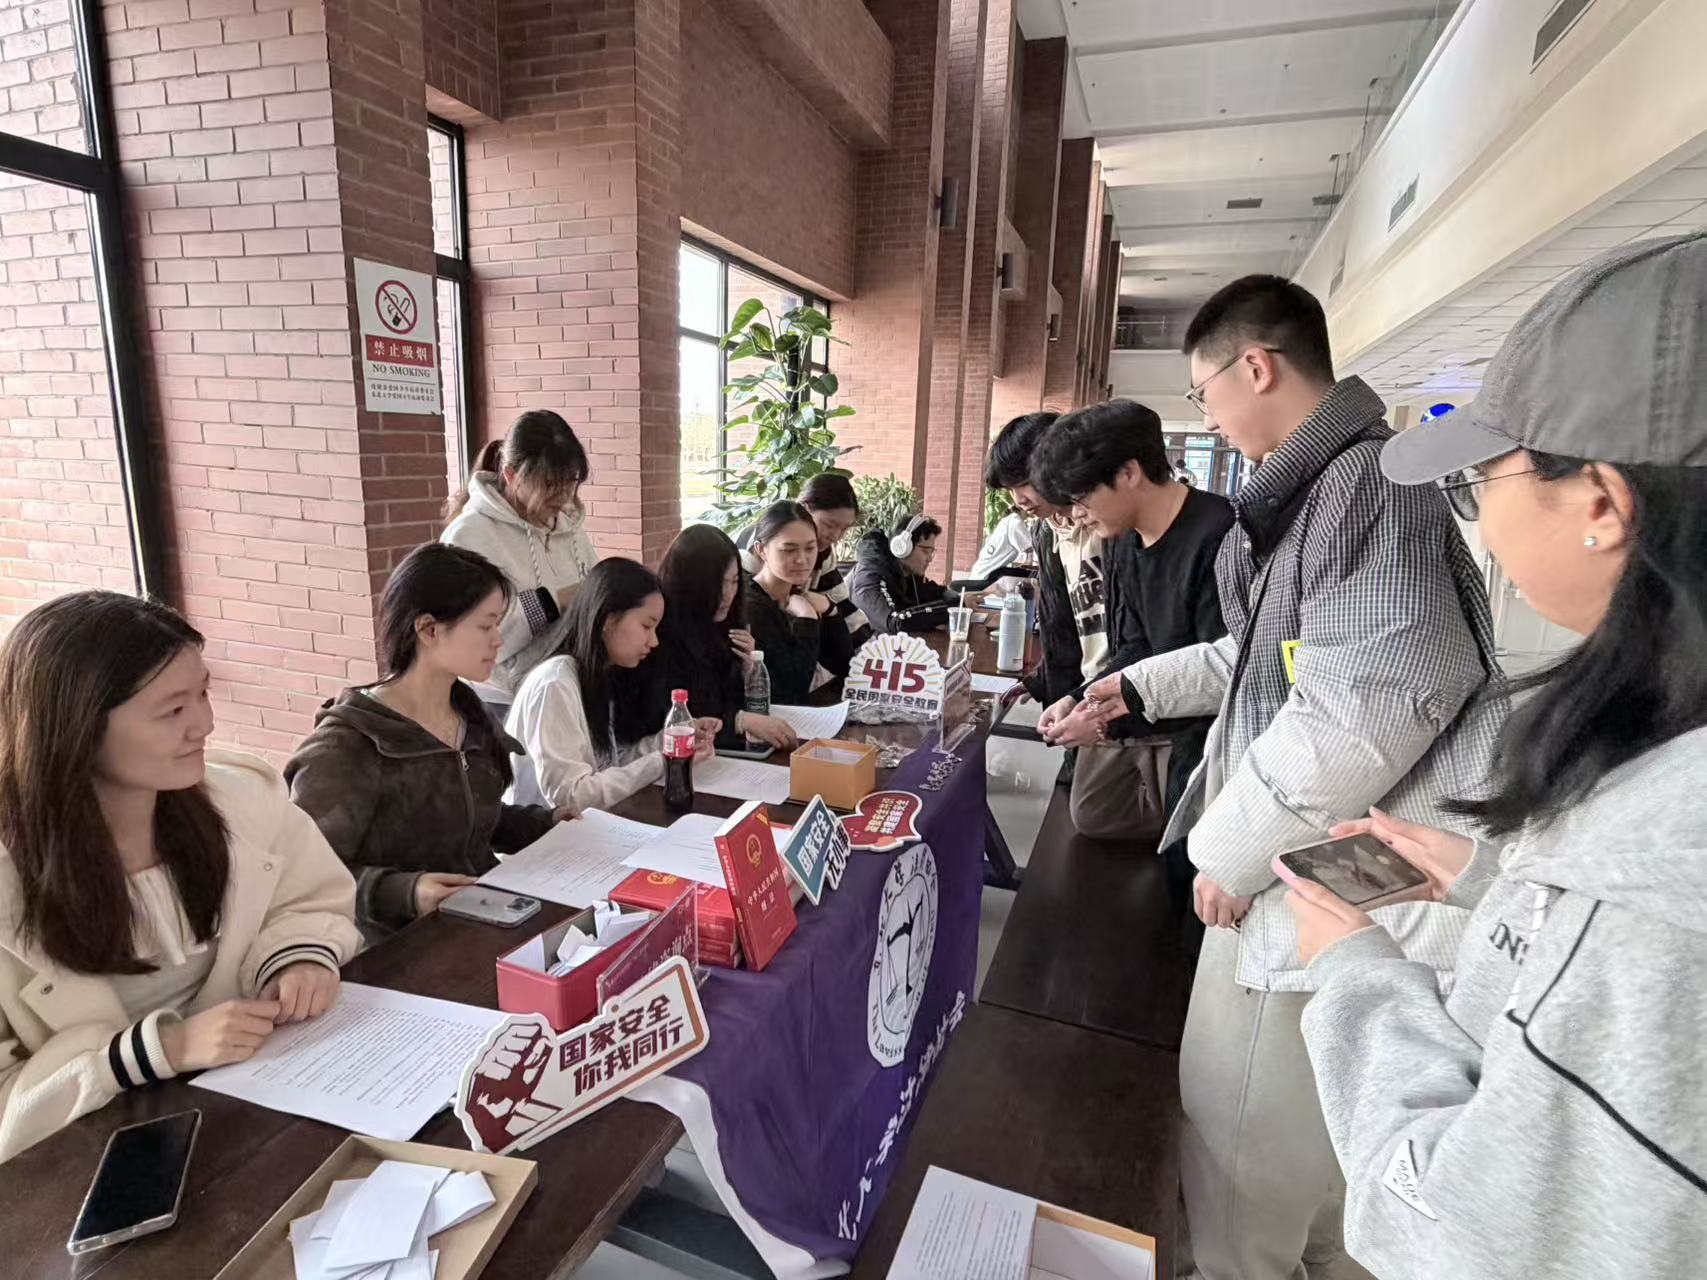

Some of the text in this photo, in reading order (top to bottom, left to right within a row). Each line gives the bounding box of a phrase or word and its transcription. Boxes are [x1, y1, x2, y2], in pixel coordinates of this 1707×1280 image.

[372, 364, 431, 378] NO SMOKING
[373, 340, 427, 360] 禁止吸烟
[862, 658, 927, 694] 415
[797, 810, 831, 878] 国家安全
[825, 821, 849, 886] 无小事
[559, 994, 671, 1072] 国家安全
[573, 1016, 684, 1097] 你我同行
